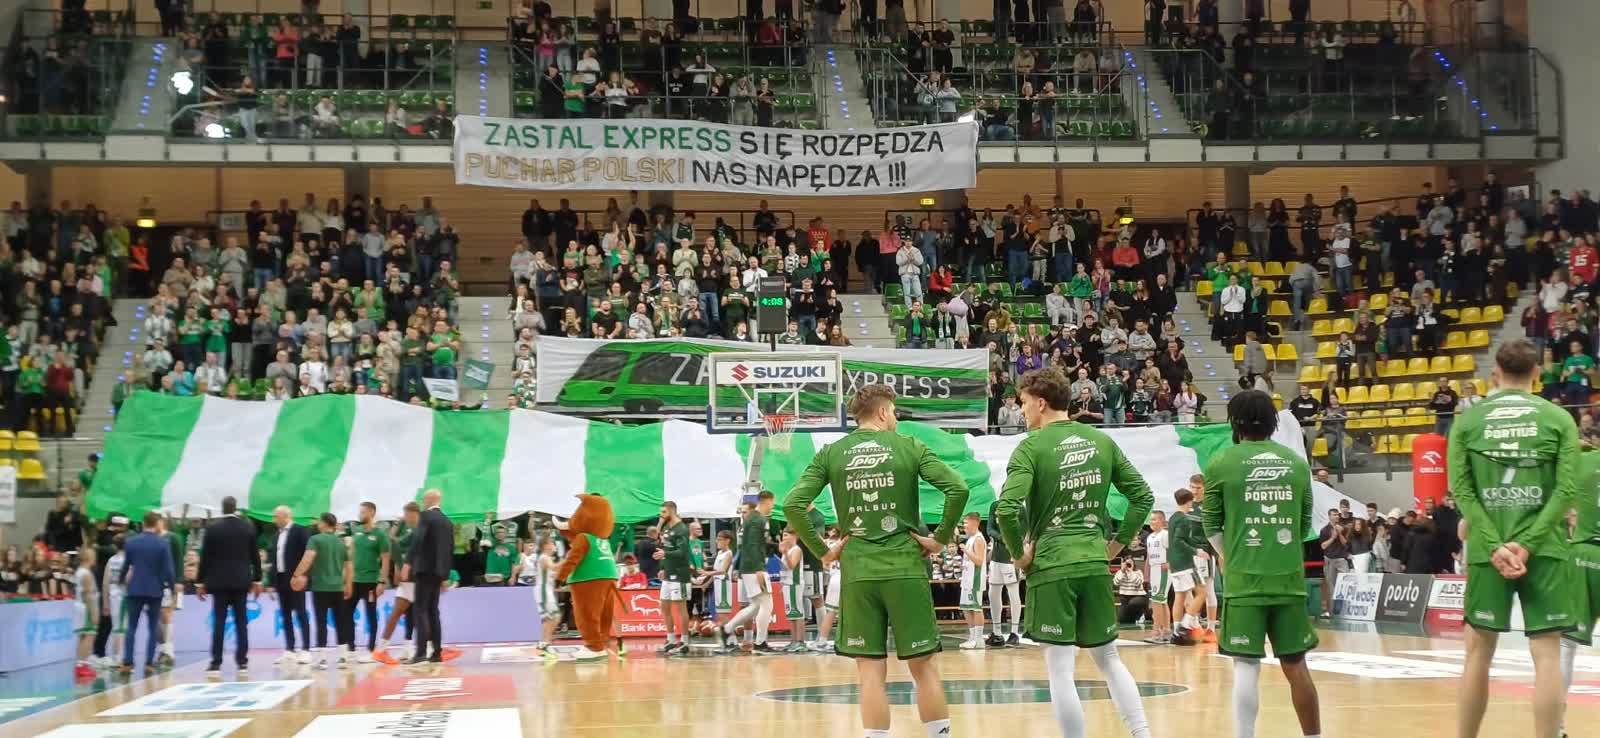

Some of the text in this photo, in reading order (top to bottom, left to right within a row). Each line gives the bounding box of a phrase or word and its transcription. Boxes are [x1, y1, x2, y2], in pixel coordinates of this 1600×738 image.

[483, 122, 944, 160] ZASTAL EXPRESS SIĘ ROZPĘDZA
[464, 152, 906, 192] PUCHAR POLSKI NAS NAPĘDZA !!!
[753, 365, 826, 379] SUZUKI
[1484, 427, 1538, 439] PORTIUS
[846, 477, 895, 491] PORTIUS
[1060, 474, 1102, 491] PORTIUS
[1245, 491, 1293, 502] PORTIUS
[1482, 486, 1543, 500] KROSNO
[848, 503, 896, 514] MALBUD
[1245, 517, 1293, 525] MALBUD
[621, 623, 647, 633] Bank
